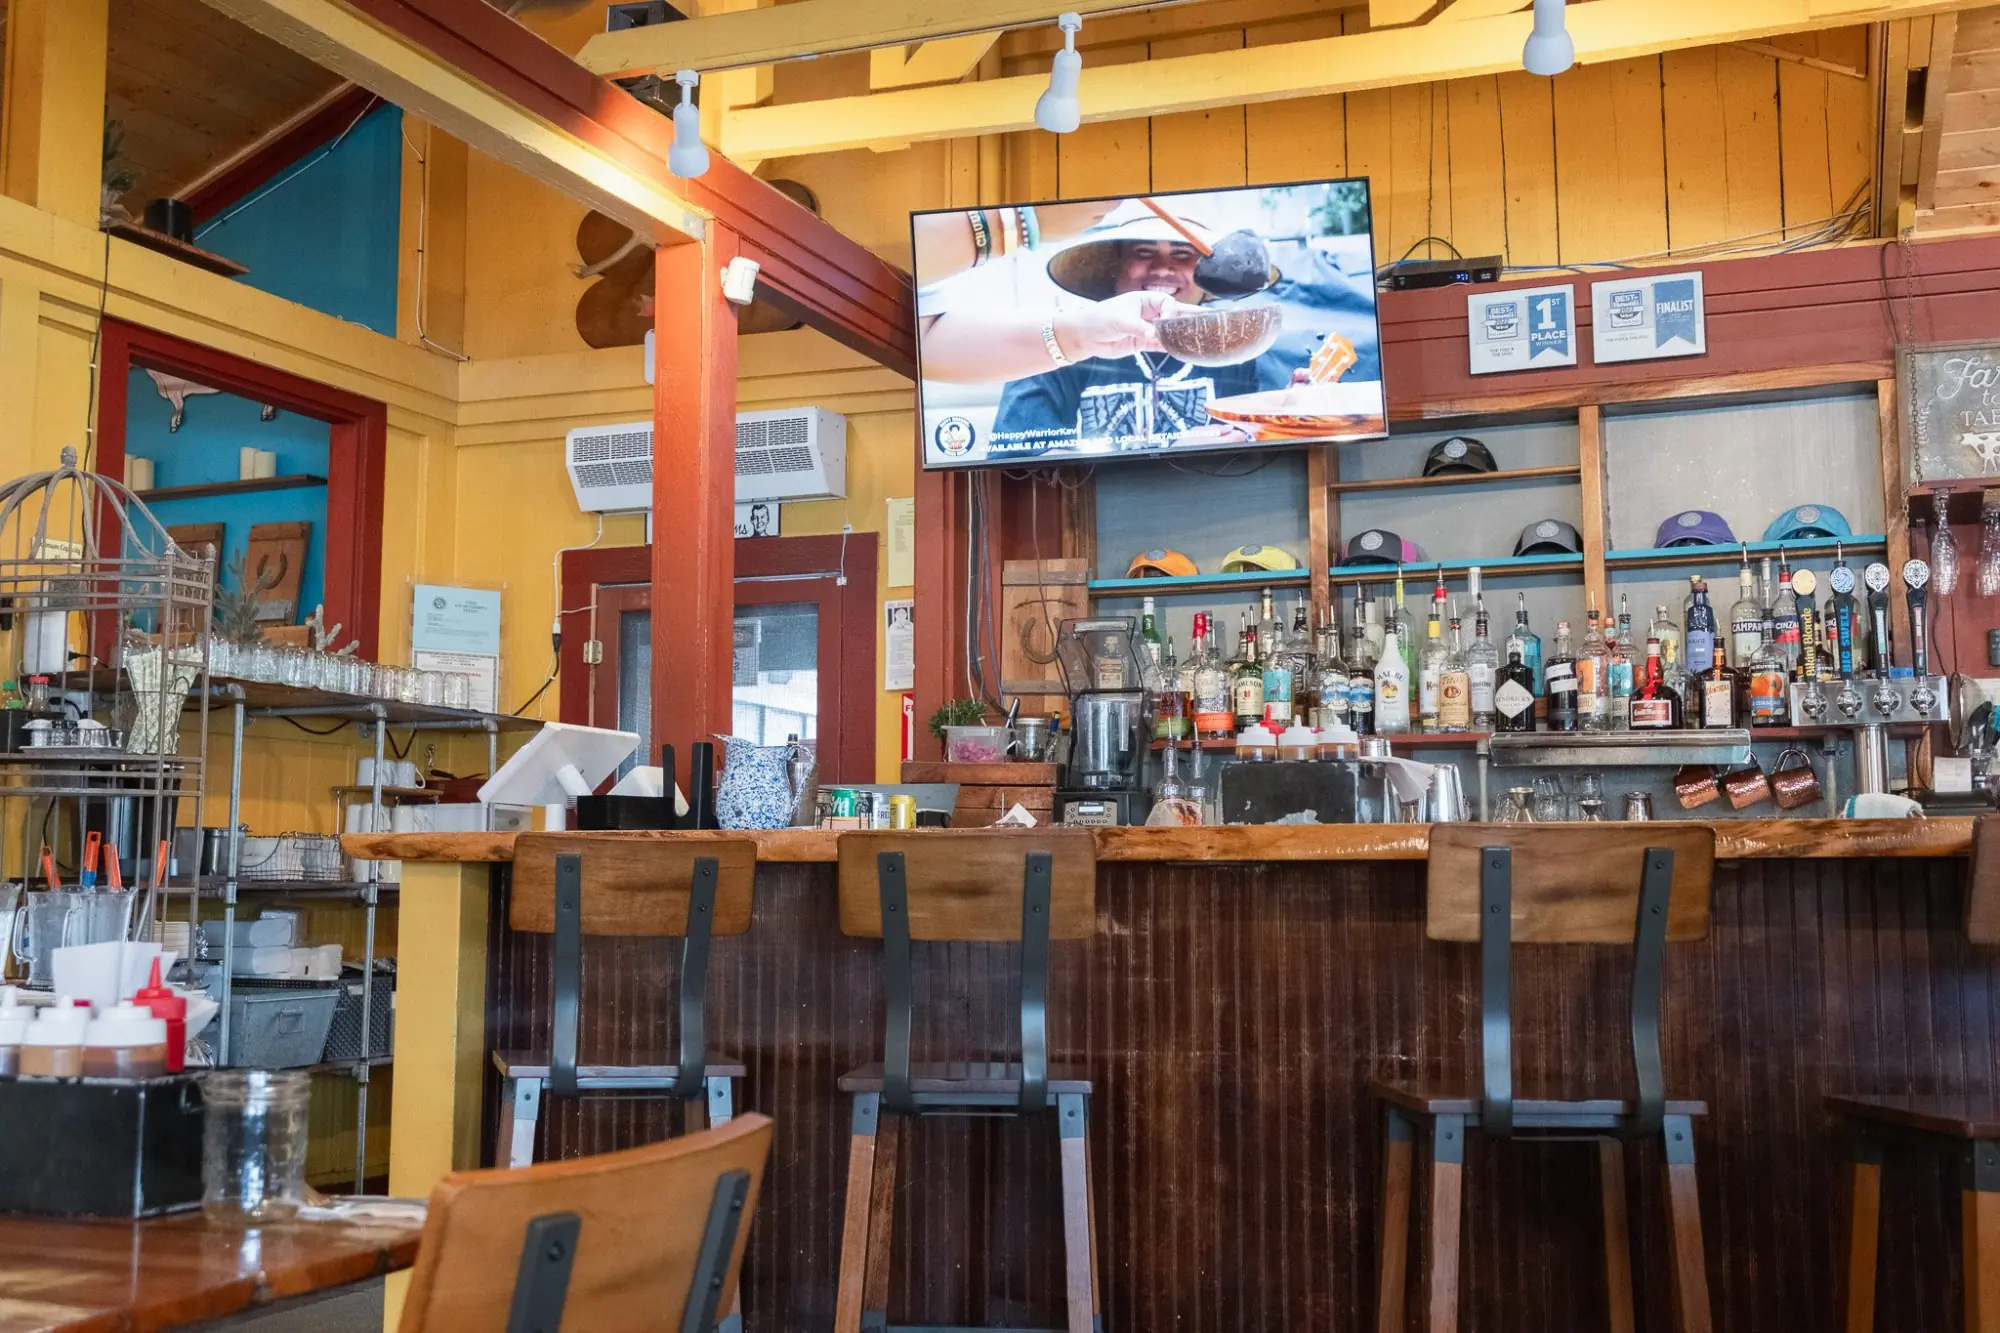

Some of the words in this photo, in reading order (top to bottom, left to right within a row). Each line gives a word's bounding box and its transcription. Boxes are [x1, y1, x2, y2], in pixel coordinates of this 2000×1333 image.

[1614, 294, 1634, 302] BEST
[1656, 299, 1694, 314] FINALIST
[1530, 329, 1567, 341] PLACE
[1034, 439, 1046, 448] AT
[1732, 622, 1762, 633] CAMPAR
[1775, 620, 1799, 630] CINZA
[1803, 607, 1813, 645] Blonde
[1840, 606, 1850, 648] SWELL
[1804, 646, 1815, 677] Bikini
[1842, 650, 1851, 672] BIG
